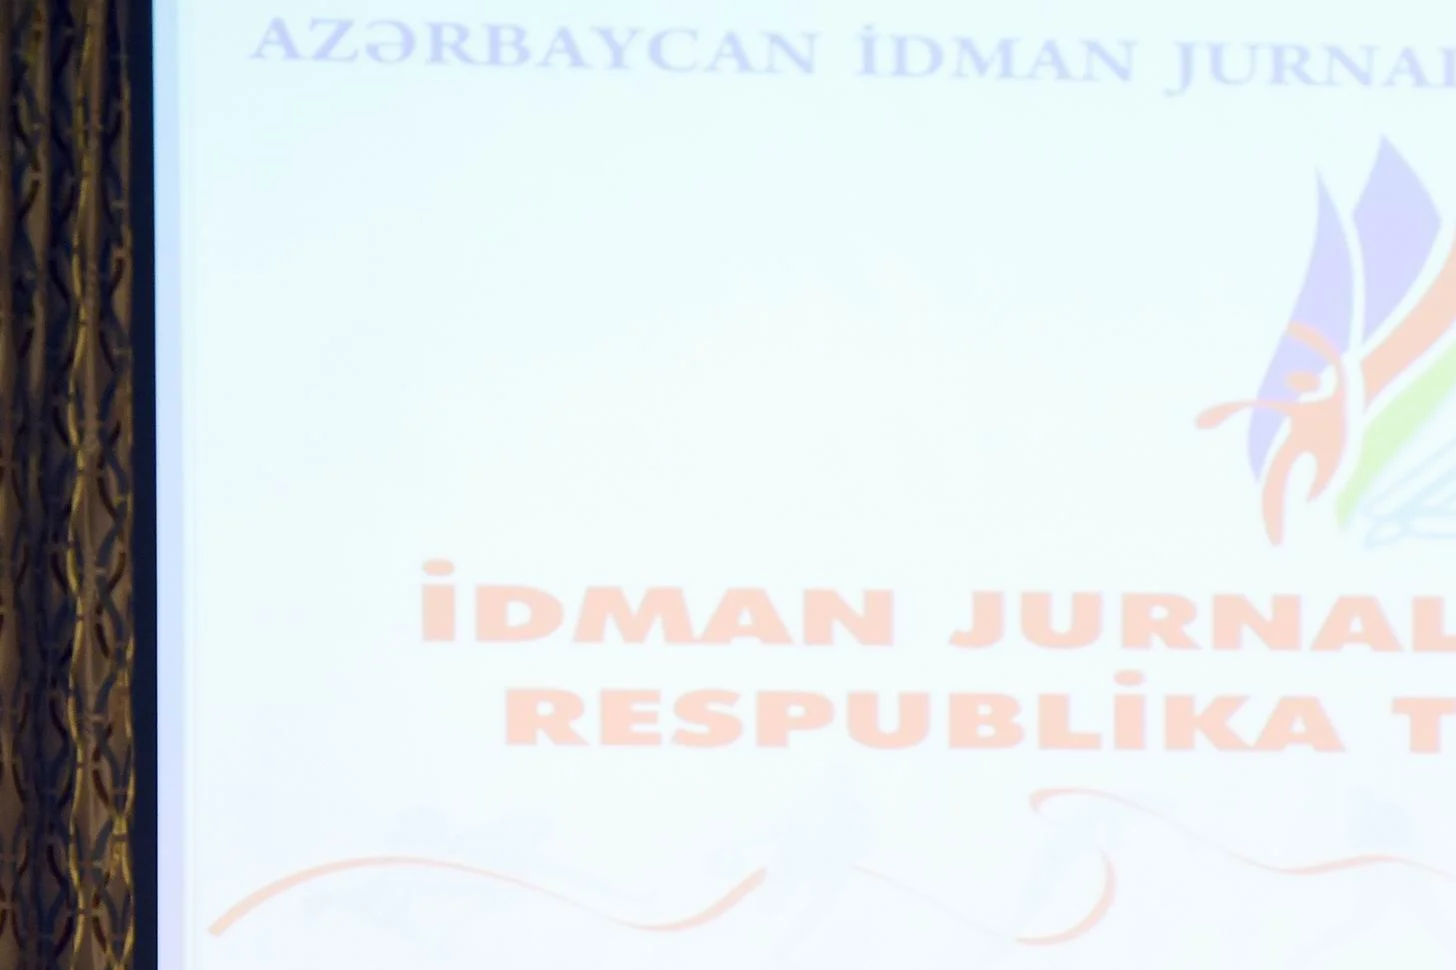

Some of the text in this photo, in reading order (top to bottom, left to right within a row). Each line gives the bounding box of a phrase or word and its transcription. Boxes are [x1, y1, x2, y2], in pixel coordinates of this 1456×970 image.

[248, 15, 820, 75] AZƏRBAYCAN
[854, 23, 1137, 82] İDMAN
[423, 561, 893, 647] İDMAN
[506, 673, 1341, 752] RESPUBLİKA
